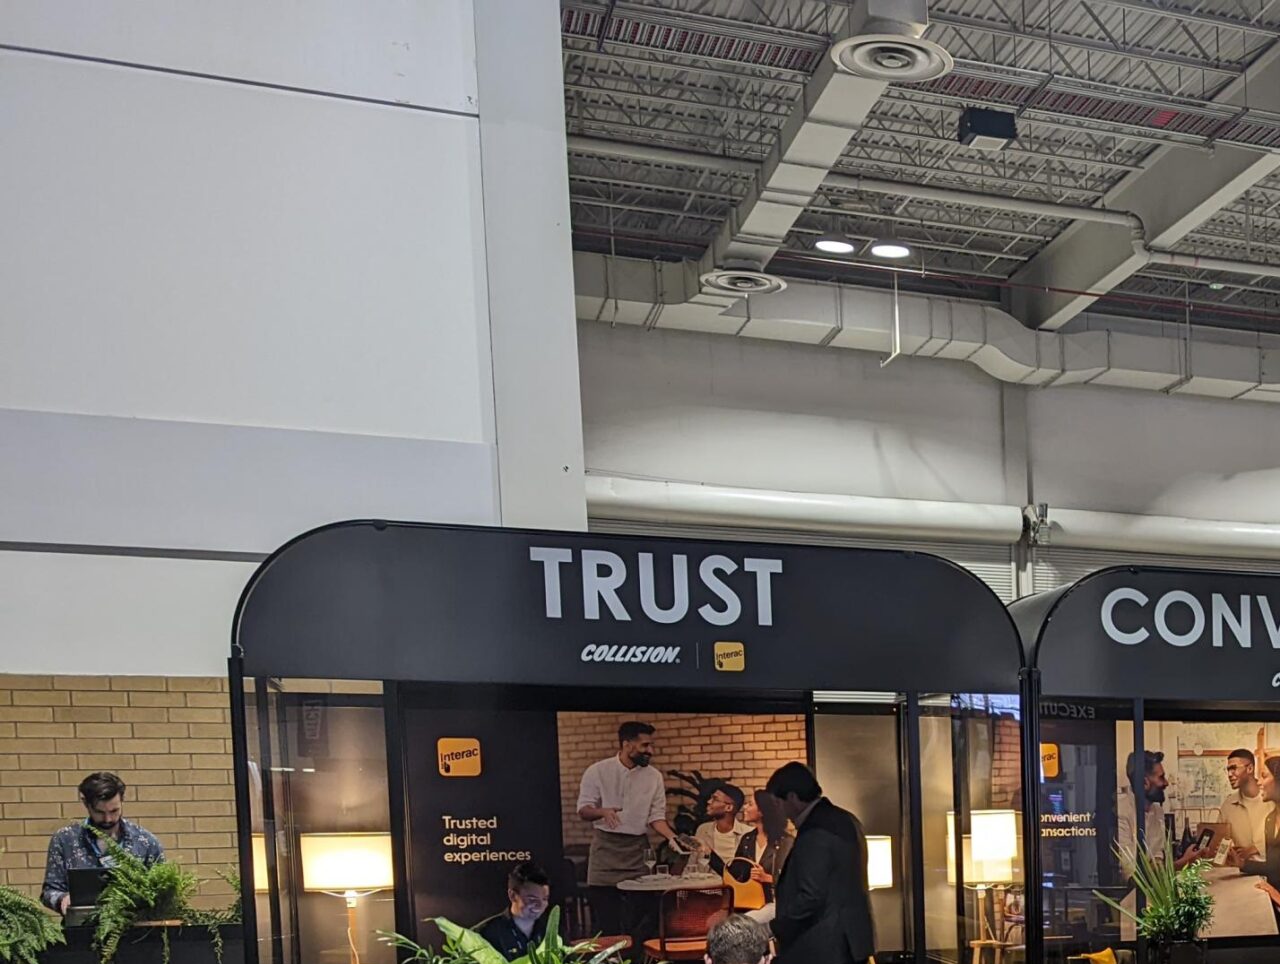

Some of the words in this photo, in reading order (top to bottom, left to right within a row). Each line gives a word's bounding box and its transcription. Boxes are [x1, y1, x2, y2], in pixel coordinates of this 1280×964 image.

[529, 546, 783, 627] TRUST
[580, 643, 681, 664] COLLISION
[716, 649, 744, 661] Interac
[440, 747, 479, 762] Interac
[442, 815, 497, 829] Trusted
[443, 833, 491, 849] digital
[444, 850, 531, 865] experiences
